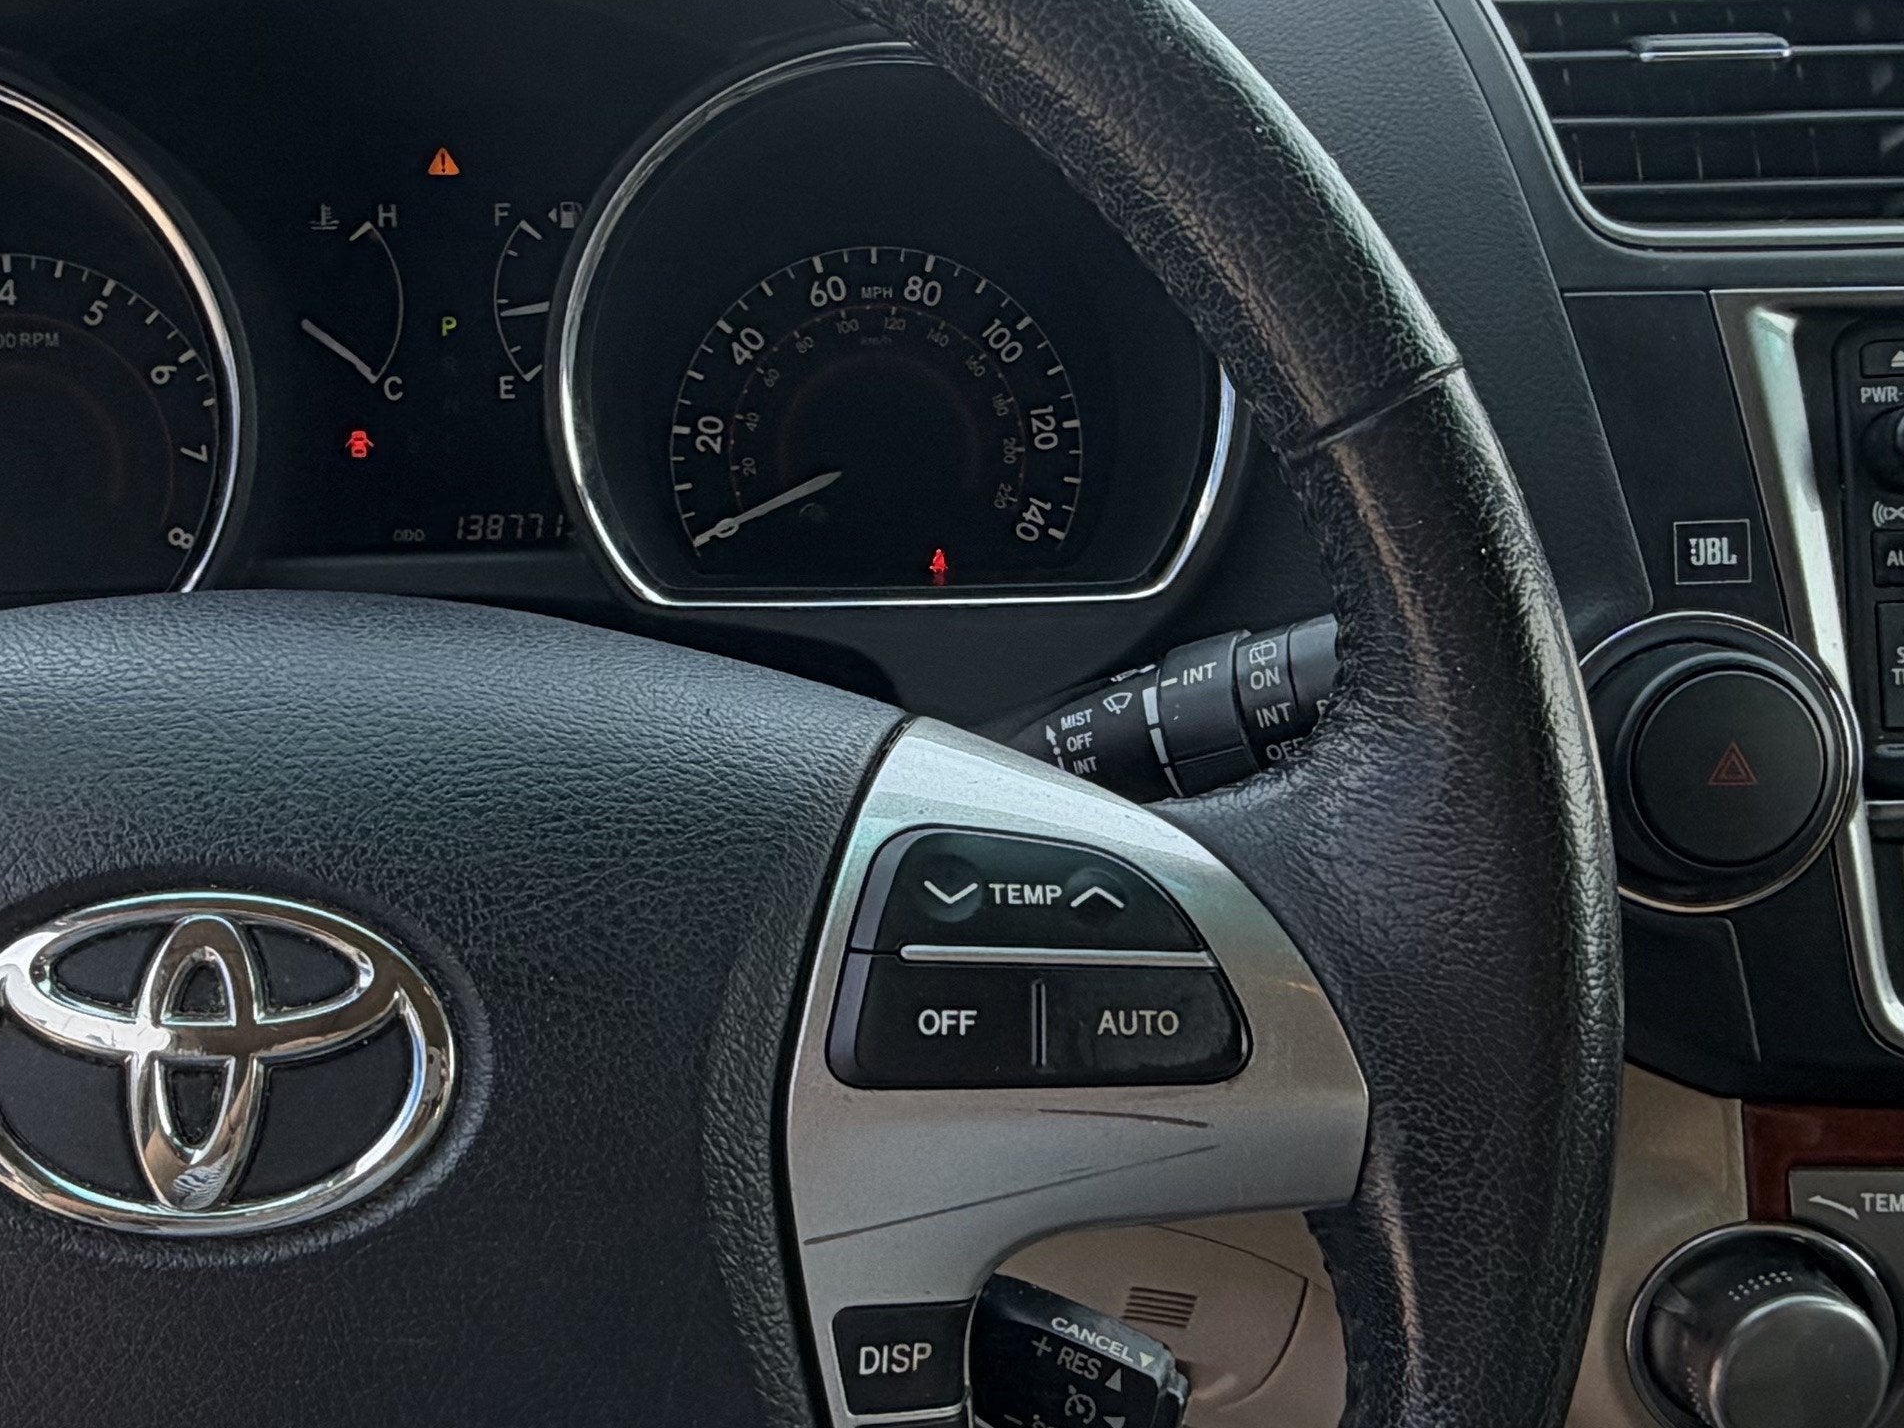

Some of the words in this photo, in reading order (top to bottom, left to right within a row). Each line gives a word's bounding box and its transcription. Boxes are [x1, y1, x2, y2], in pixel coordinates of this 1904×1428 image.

[377, 204, 397, 228] H
[494, 203, 511, 226] F
[810, 276, 847, 308] 60
[861, 286, 893, 300] MPH
[903, 276, 942, 307] 80
[83, 301, 109, 327] 5
[441, 317, 457, 336] P
[731, 326, 765, 365] 40
[981, 319, 1023, 364] 100
[150, 364, 178, 386] 6
[499, 376, 516, 399] E
[384, 376, 404, 401] C
[695, 416, 724, 454] 20
[1029, 405, 1058, 451] 120
[180, 443, 209, 464] 7
[1015, 497, 1053, 542] 140
[168, 526, 195, 551] 8
[1689, 537, 1737, 566] JBL
[1183, 661, 1218, 686] INT
[1250, 667, 1282, 691] ON
[1060, 708, 1094, 732] MIST
[1255, 702, 1291, 729] INT
[1066, 732, 1094, 753] OFF
[1072, 756, 1097, 775] INT
[989, 882, 1062, 905] TEMP
[917, 1008, 978, 1036] OFF
[1097, 1008, 1180, 1036] AUTO
[1050, 1317, 1134, 1364] CANCEL
[858, 1342, 933, 1376] DISP
[1056, 1346, 1102, 1380] RES
